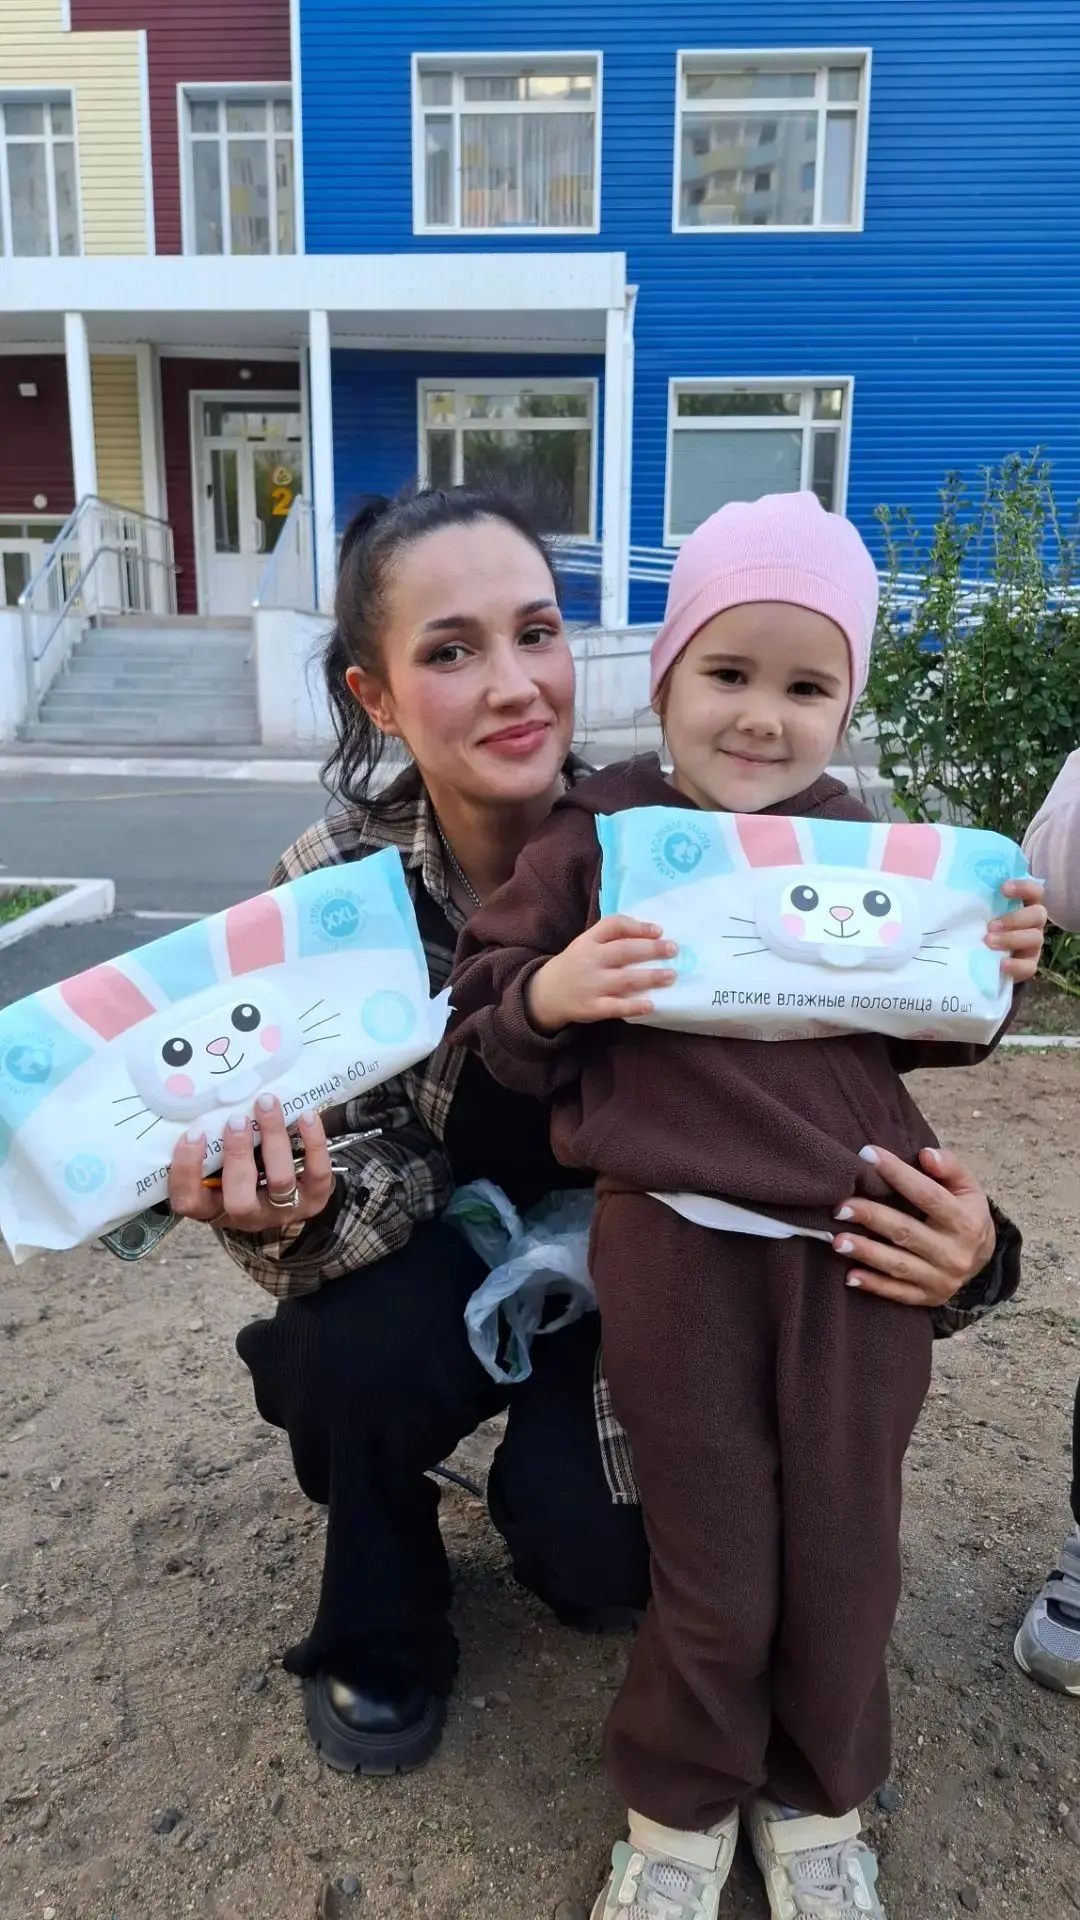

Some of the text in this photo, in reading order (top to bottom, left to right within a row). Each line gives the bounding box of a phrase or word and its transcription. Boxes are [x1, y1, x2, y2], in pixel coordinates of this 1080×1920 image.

[271, 487, 293, 516] 2
[323, 905, 358, 931] XXL
[711, 990, 771, 1006] детские
[777, 993, 845, 1008] влажные
[851, 995, 932, 1013] полотенца
[283, 1075, 341, 1116] лотенца
